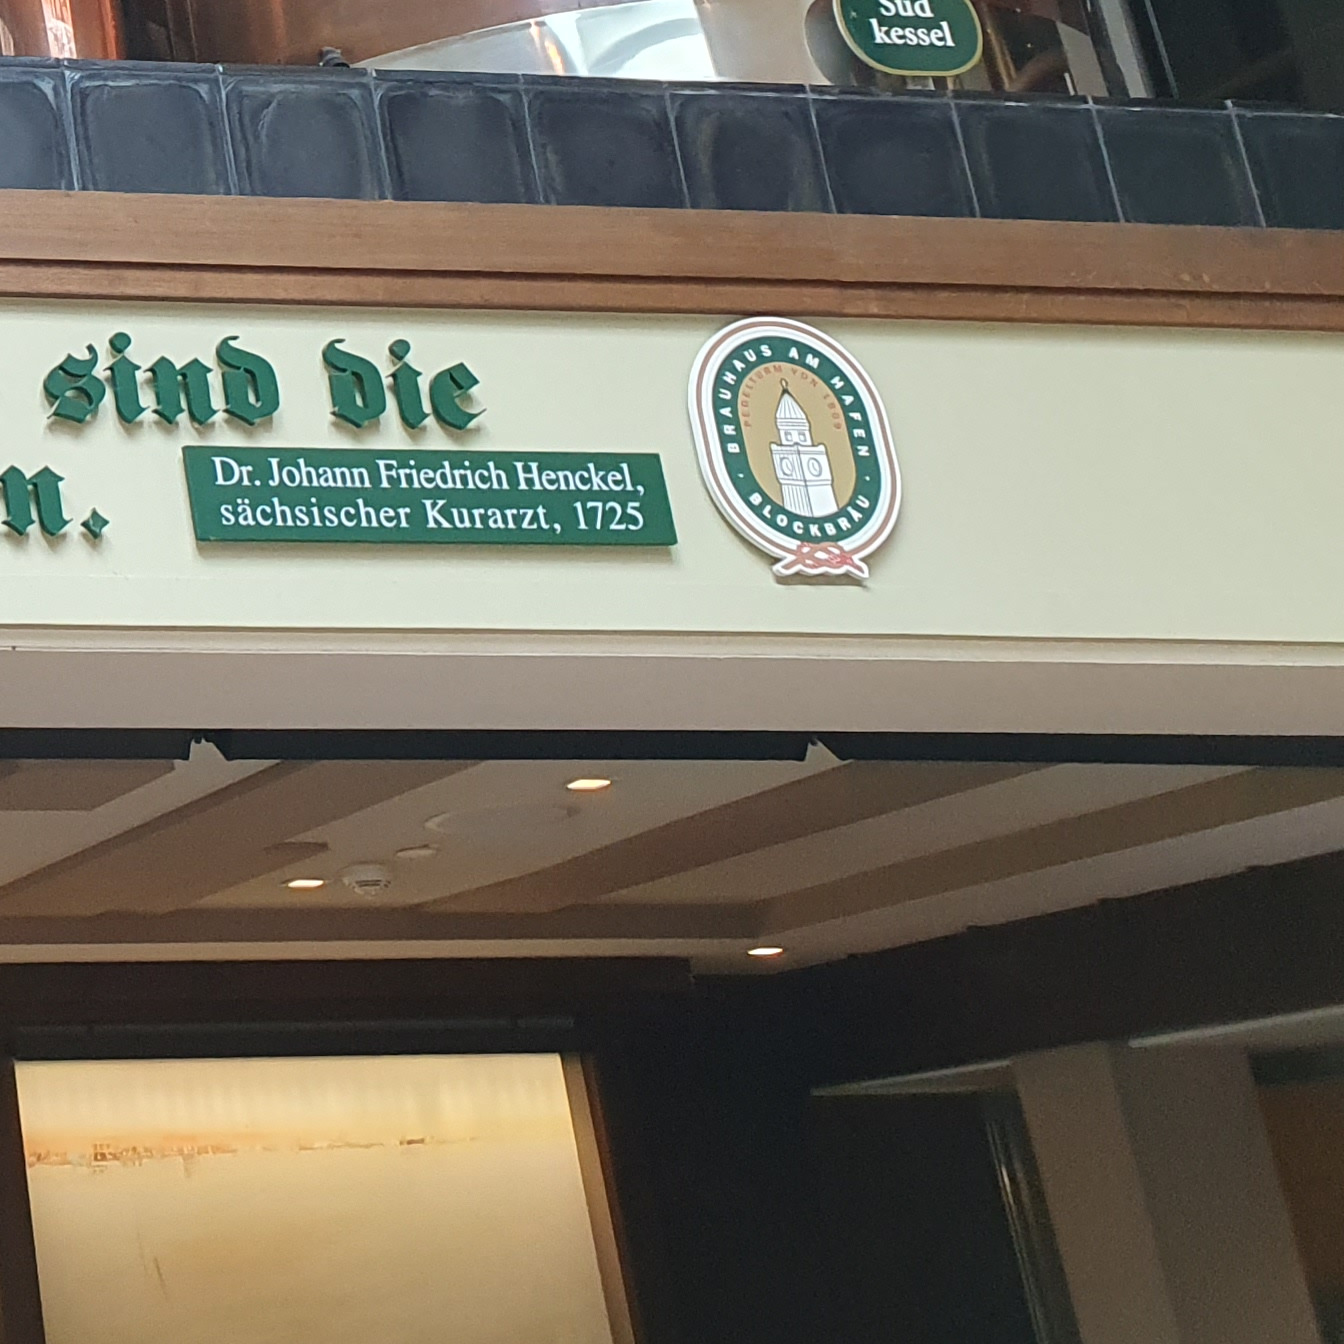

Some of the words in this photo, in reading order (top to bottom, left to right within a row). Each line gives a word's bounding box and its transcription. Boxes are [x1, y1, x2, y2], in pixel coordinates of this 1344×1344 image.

[869, 18, 956, 47] kessel
[43, 331, 281, 426] sind
[322, 339, 481, 432] die
[718, 344, 773, 454] BRAUHAUS
[788, 346, 820, 369] AM
[829, 375, 871, 457] HAFEN
[211, 456, 261, 487] Dr.
[267, 458, 373, 489] Johann
[375, 459, 511, 491] Friedrich
[514, 461, 645, 495] Henckel,
[219, 497, 412, 528] sächsischer
[422, 499, 562, 534] Kurarzt,
[574, 500, 645, 531] 1725
